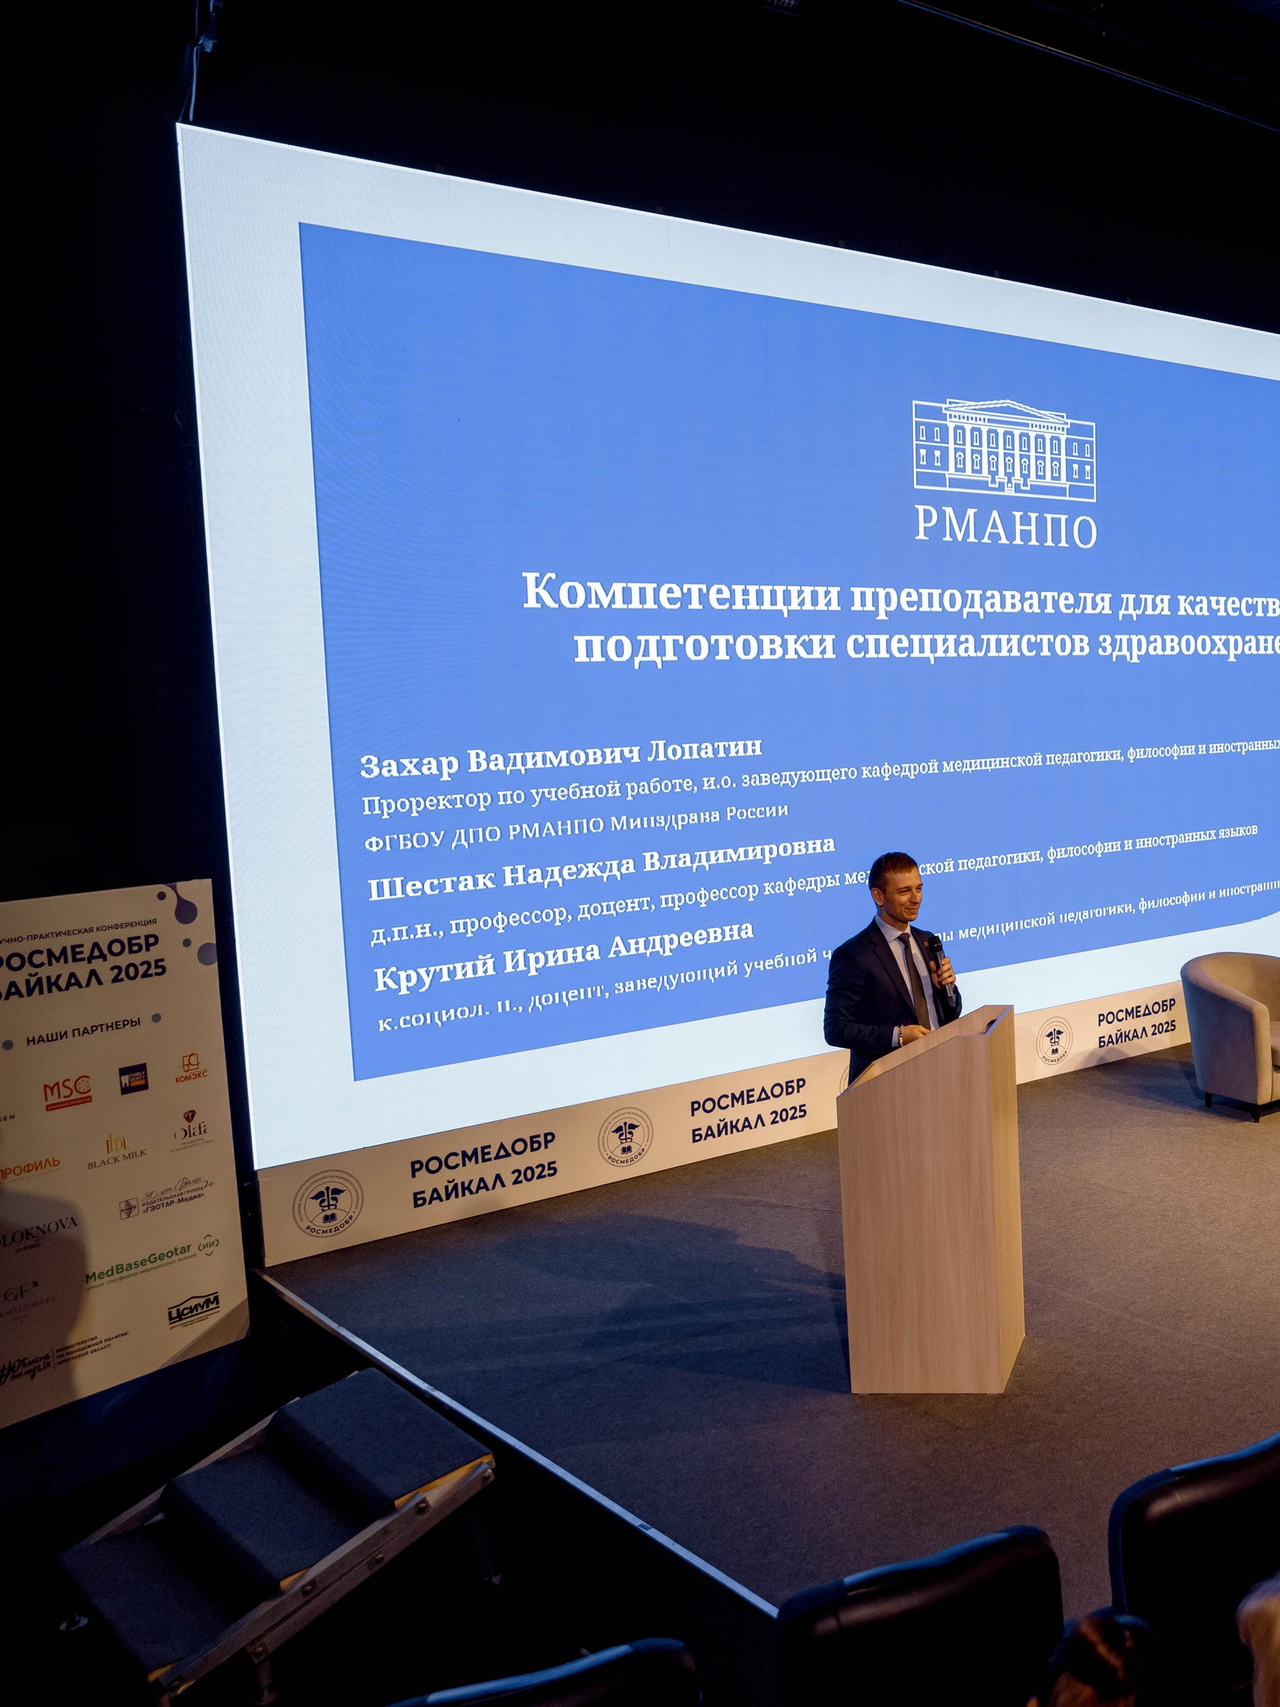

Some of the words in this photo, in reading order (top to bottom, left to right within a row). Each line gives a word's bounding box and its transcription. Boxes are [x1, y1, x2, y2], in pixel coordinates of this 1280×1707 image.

[914, 504, 1098, 549] РМАНПО
[521, 571, 842, 617] Компетенции
[850, 585, 1113, 622] преподавателя
[1118, 592, 1170, 621] для
[573, 630, 837, 670] подготовки
[846, 631, 1090, 665] специалистов
[360, 754, 459, 782] Захар
[466, 746, 641, 776] Вадимович
[646, 739, 763, 762] Лопатин
[361, 792, 492, 820] Проректор
[497, 789, 525, 806] по
[529, 779, 622, 808] учебной
[624, 777, 698, 801] работе,
[701, 775, 737, 791] и.о.
[741, 767, 858, 789] заведующего
[860, 758, 940, 782] кафедрой
[941, 751, 1044, 774] медицинской
[1045, 749, 1125, 767] педагогики,
[1126, 743, 1197, 764] философии
[1197, 744, 1207, 755] и
[364, 830, 445, 853] ФГБОУ
[451, 825, 501, 851] ДПО
[508, 817, 605, 841] РМАНПО
[610, 810, 720, 832] Минздрава
[726, 804, 789, 821] России
[367, 872, 497, 902] Шестак
[501, 858, 636, 889] Надежда
[642, 837, 836, 873] Владимировна
[370, 922, 444, 948] д.п.н.,
[449, 906, 573, 938] профессор,
[577, 896, 656, 922] доцент,
[659, 883, 760, 912] профессор
[762, 873, 841, 897] кафедры
[957, 850, 1044, 872] педагогики,
[1046, 839, 1122, 864] философии
[1123, 838, 1133, 850] и
[1134, 829, 1217, 851] иностранных
[1217, 824, 1259, 840] языков
[1138, 890, 1206, 914] философии
[1208, 889, 1216, 900] и
[95, 918, 158, 932] КОНФЕРЕНЦИЯ
[0, 933, 160, 972] ОСМЕДОБР
[373, 953, 497, 996] Крутий
[502, 943, 602, 977] Ирина
[607, 922, 755, 959] Андреевна
[0, 969, 104, 1001] АЙКАЛ
[108, 958, 168, 984] 2025
[26, 1030, 69, 1047] НАШИ
[71, 1016, 141, 1038] ПАРТНЕРЫ
[1097, 998, 1177, 1027] РОСМЕДОБР
[1098, 1026, 1149, 1049] БАЙКАЛ
[1151, 1019, 1177, 1037] 2025
[43, 1074, 92, 1102] MSC
[175, 1070, 208, 1084] КОМЭКС
[690, 1077, 807, 1117] РОСМЕДОБР
[691, 1114, 766, 1145] БАЙКАЛ
[769, 1103, 808, 1127] 2025
[88, 1155, 120, 1170] BLACK
[122, 1148, 147, 1161] MILK
[410, 1131, 556, 1178] РОСМЕДОБР
[607, 1147, 646, 1164] РОСМЕДОБР
[412, 1172, 507, 1209] БАЙКАЛ
[511, 1160, 558, 1186] 2025
[305, 1214, 354, 1235] РОСМЕДОБР
[85, 1244, 192, 1285] MedBaseGeotar
